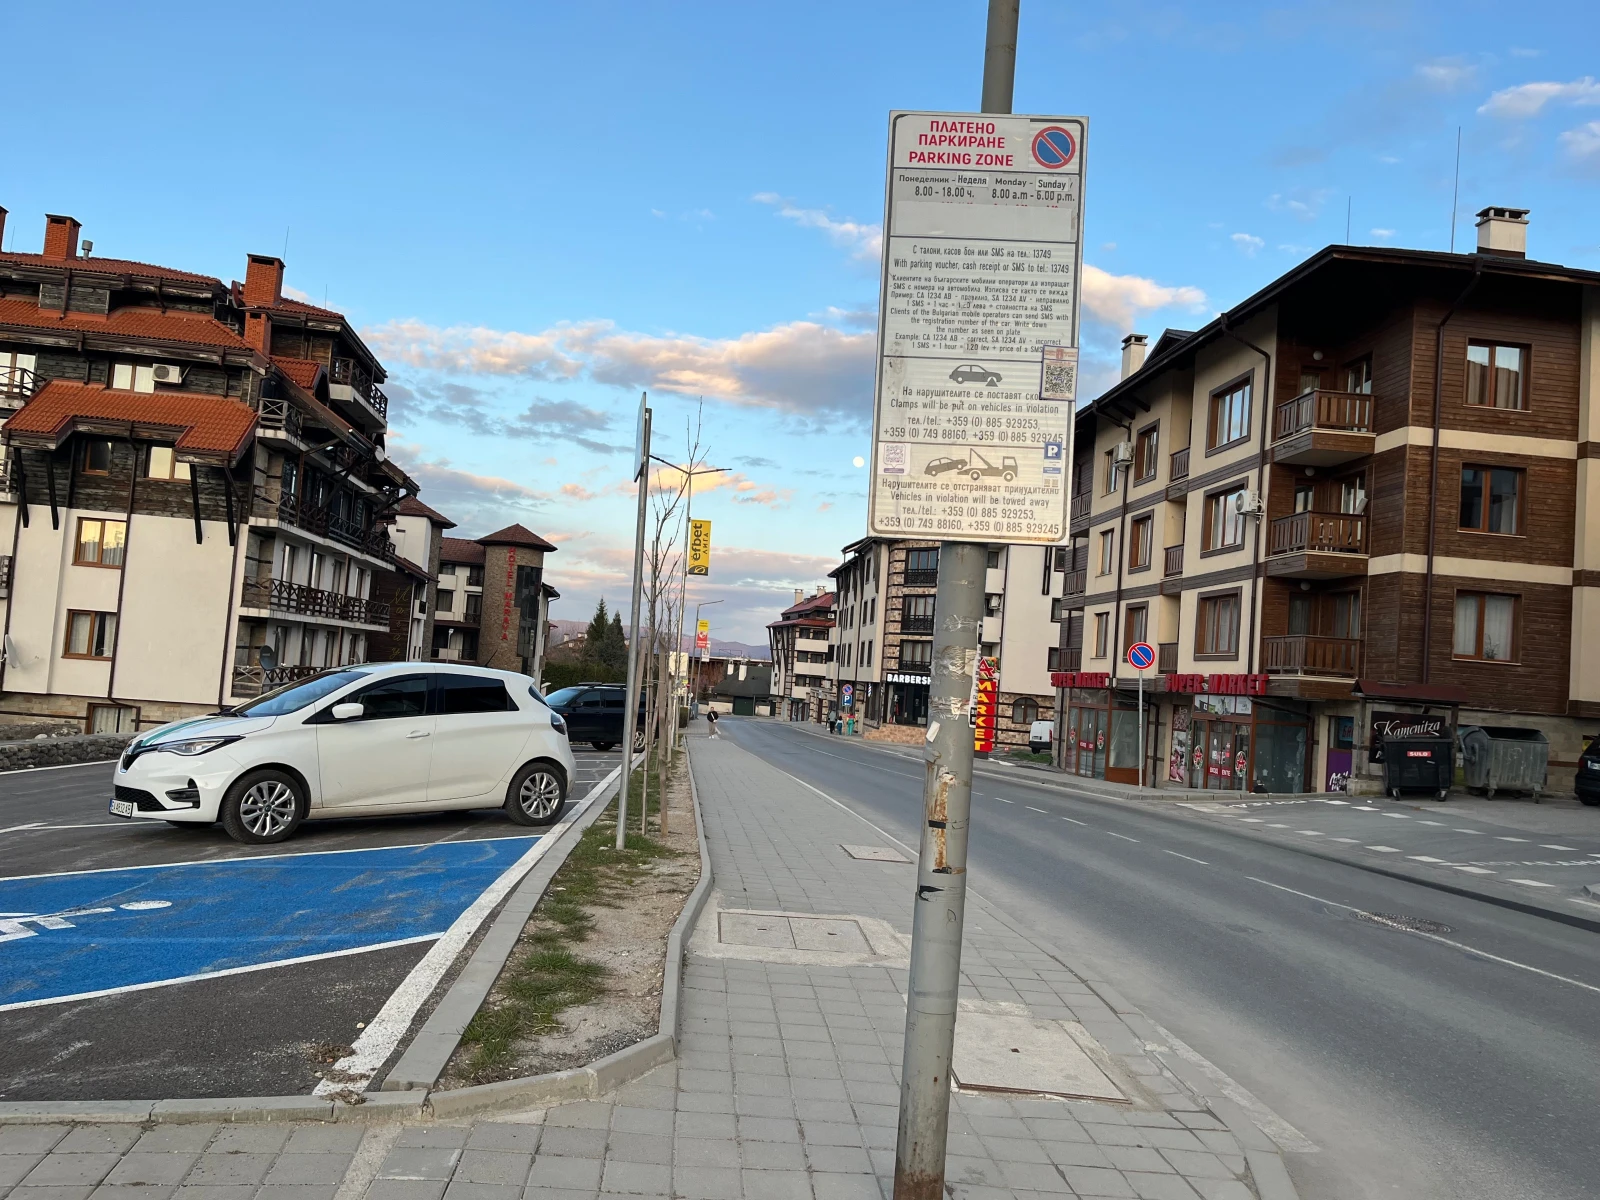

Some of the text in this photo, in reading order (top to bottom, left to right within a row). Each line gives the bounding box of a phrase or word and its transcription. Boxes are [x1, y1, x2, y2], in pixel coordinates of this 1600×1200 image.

[930, 120, 994, 134] ПЛАТЕНО
[918, 134, 1005, 148] ПАРКИРАНЕ
[909, 151, 1013, 166] PARKING ZONE
[899, 174, 986, 185] Понеделник Неделя
[995, 178, 1066, 189] Monday Sunday
[914, 185, 932, 196] 8.00
[942, 186, 964, 197] 18.00
[991, 188, 1009, 198] 8.00
[1036, 190, 1054, 200] 6.00
[1056, 193, 1074, 203] p.m.
[893, 258, 907, 267] With
[909, 259, 932, 270] parking
[934, 259, 959, 269] voucher,
[962, 260, 976, 269] cash
[979, 261, 1000, 273] receipt
[1011, 262, 1024, 271] SMS
[1027, 263, 1034, 272] to
[1050, 263, 1069, 273] 13749
[902, 386, 912, 395] На
[916, 388, 970, 398] нарушителите
[986, 391, 1021, 400] поставят
[890, 398, 918, 410] Clamps
[921, 400, 936, 408] will
[939, 400, 948, 409] be
[951, 401, 964, 412] put
[980, 402, 1011, 412] vehicles
[1015, 404, 1022, 412] in
[1026, 404, 1058, 416] violation
[946, 415, 968, 426] +359
[971, 416, 982, 427] (0)
[985, 417, 1002, 428] 885
[1005, 418, 1040, 430] 929253,
[883, 426, 1063, 446] +359 (0) 749 88160, +359 (0) 885 929245
[882, 477, 937, 490] Нарушителите
[952, 483, 1001, 493] отстраняват
[1004, 485, 1059, 495] принудително
[890, 490, 1049, 508] Vehicles in violation will be towed away
[941, 505, 963, 516] +359
[966, 506, 977, 517] (0)
[981, 507, 997, 518] 885
[1001, 508, 1036, 520] 929253,
[878, 516, 1059, 534] +359 (0) 749 88160, +359 (0) 885 929245
[692, 522, 702, 561] efbet
[506, 547, 516, 587] HOTEL
[886, 674, 932, 685] BARBERSH
[1050, 672, 1110, 688] SUPER MARKET
[1165, 674, 1269, 695] SUPER MARKET
[974, 681, 992, 750] MARKET
[1374, 720, 1440, 738] Kamenitza
